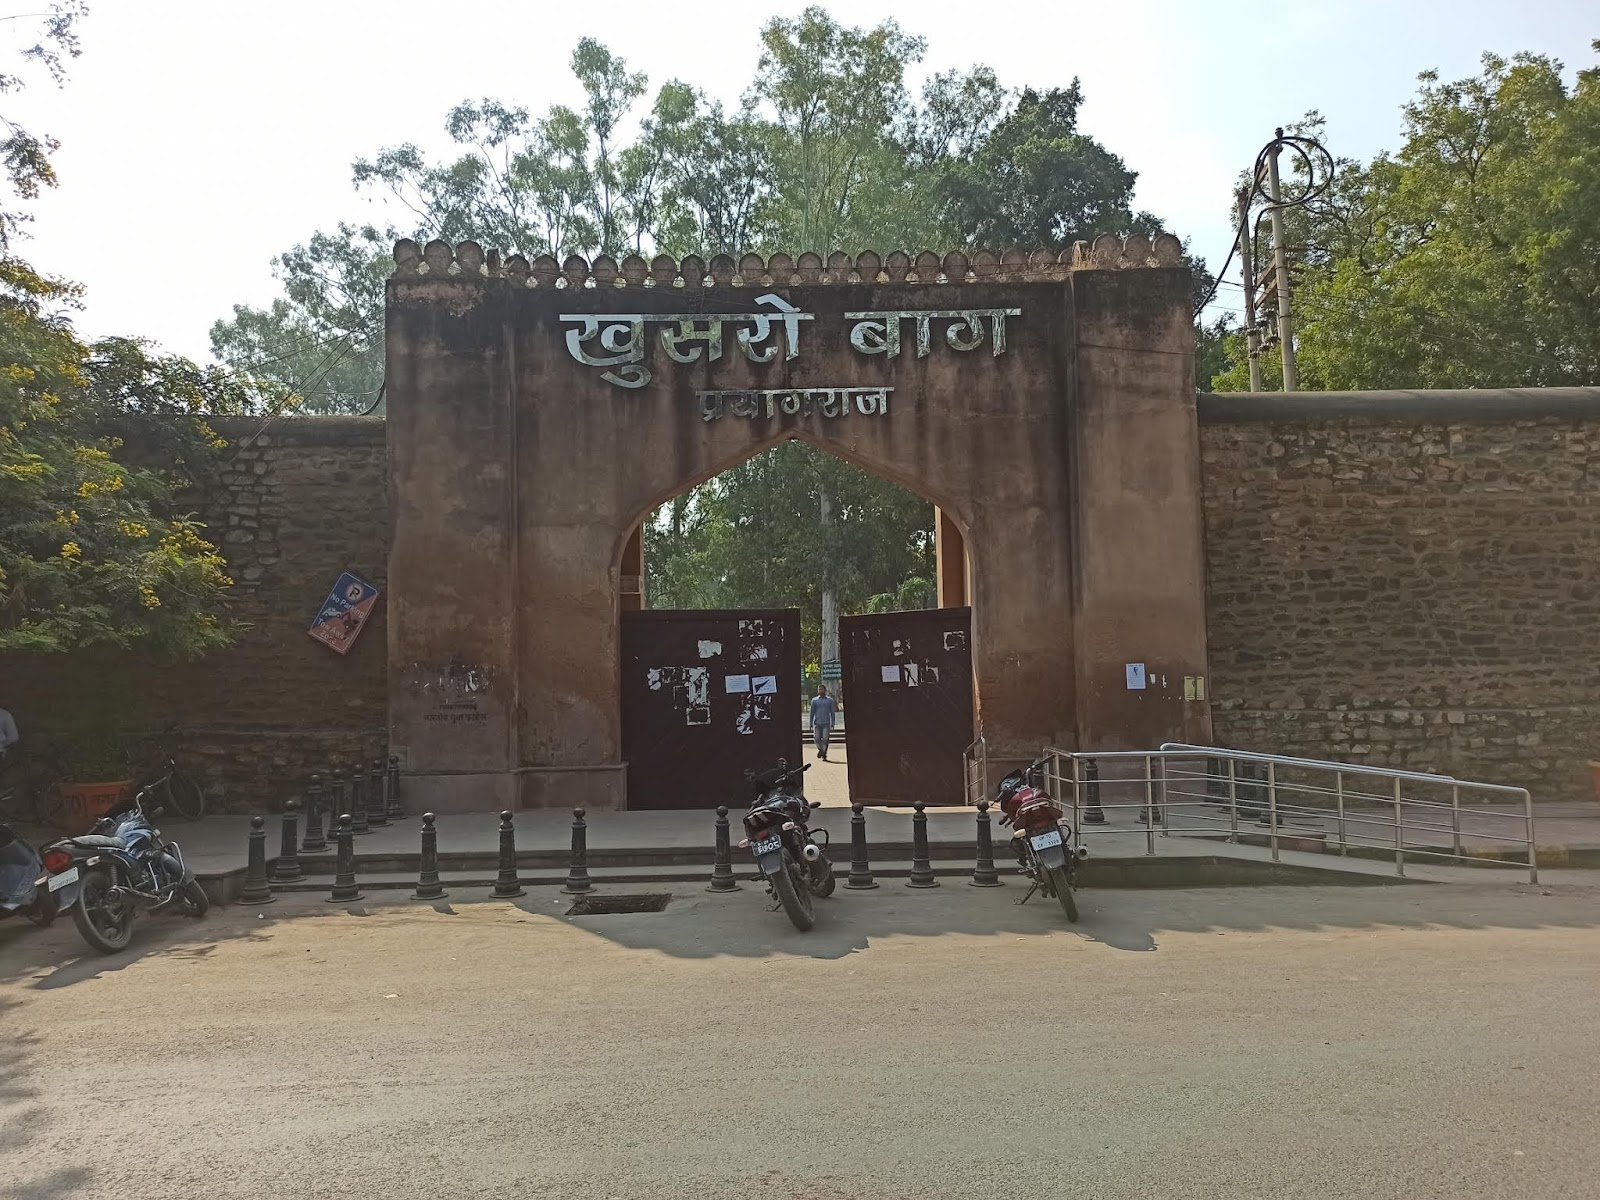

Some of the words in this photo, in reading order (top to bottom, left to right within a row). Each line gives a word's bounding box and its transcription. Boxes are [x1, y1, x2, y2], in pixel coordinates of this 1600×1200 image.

[559, 293, 815, 389] खुसरो
[845, 308, 1022, 359] बाग
[697, 386, 895, 422] प्रयागराज
[330, 594, 340, 603] No
[340, 600, 365, 618] Parking
[318, 618, 331, 630] Tow
